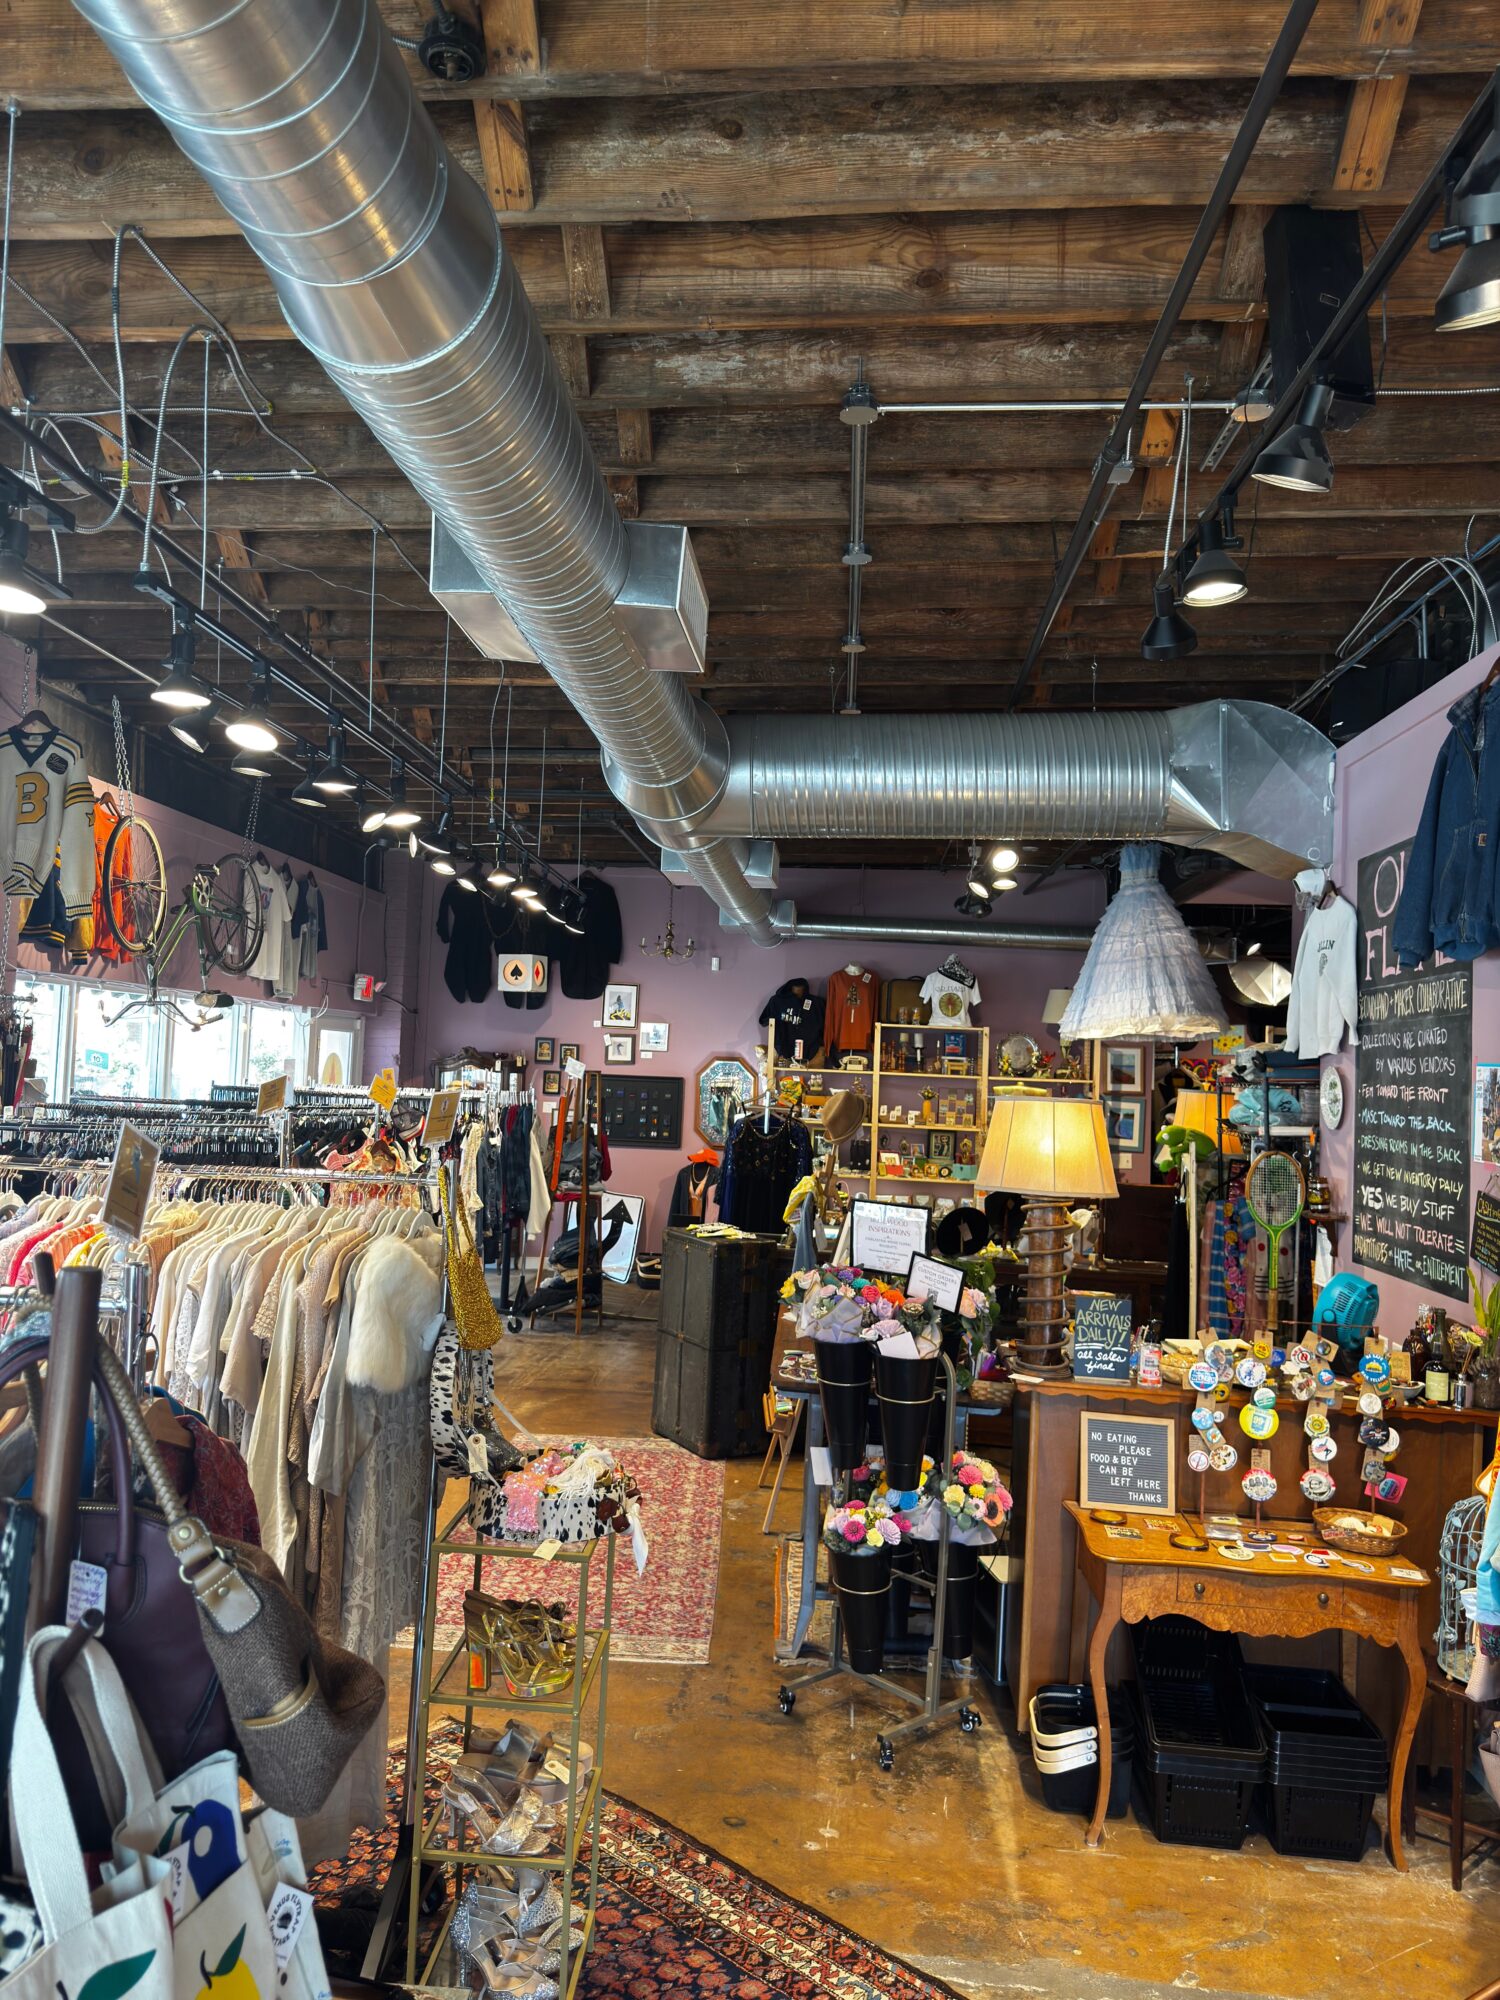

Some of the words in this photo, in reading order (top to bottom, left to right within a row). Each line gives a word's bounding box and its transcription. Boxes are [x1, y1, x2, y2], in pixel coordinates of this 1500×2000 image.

[16, 771, 50, 825] B
[1394, 985, 1414, 1018] MAKER
[1416, 977, 1467, 1013] COLLABORATIVE
[1362, 1032, 1401, 1050] COLLECTIONS
[1403, 1032, 1415, 1050] ARE
[1418, 1027, 1448, 1047] CURATED
[1375, 1058, 1384, 1073] BY
[1387, 1056, 1416, 1078] VARIOUS
[1419, 1056, 1456, 1076] VENDORS
[1361, 1083, 1374, 1098] FEM
[1376, 1084, 1398, 1099] TOWARD
[1399, 1085, 1415, 1102] THE
[1418, 1086, 1449, 1104] FRONT
[1361, 1108, 1378, 1125] MASC
[1378, 1110, 1406, 1128] TOWARD
[1408, 1116, 1425, 1130] THE
[1426, 1116, 1455, 1133] BACK
[1361, 1135, 1388, 1153] DRESSING
[1388, 1138, 1408, 1155] ROOMS
[1410, 1142, 1418, 1157] IN
[1419, 1143, 1435, 1160] THE
[1436, 1145, 1463, 1164] BACK
[1361, 1160, 1372, 1175] WE
[1373, 1161, 1385, 1179] GET
[1386, 1165, 1403, 1181] NEW
[1403, 1169, 1438, 1193] INVENTORY
[1439, 1178, 1464, 1201] DAILY
[1385, 1192, 1398, 1208] WE
[1400, 1195, 1421, 1218] BUY
[1421, 1200, 1455, 1221] STUFF
[1360, 1212, 1373, 1231] WE
[1375, 1215, 1394, 1236] WILL
[1395, 1220, 1412, 1240] NOT
[1413, 1225, 1455, 1254] TOLERATE
[1393, 1247, 1415, 1273] HATE
[1422, 1255, 1466, 1290] ENTITLEMENT
[1089, 1299, 1122, 1312] NEW
[1076, 1309, 1131, 1332] ARRIVALS
[1076, 1325, 1127, 1349] DAILY!
[1077, 1351, 1093, 1359] all
[1095, 1351, 1126, 1362] sales
[1085, 1361, 1115, 1373] final
[1091, 1432, 1102, 1441] NO
[1107, 1433, 1137, 1444] EATING
[1090, 1453, 1110, 1463] FOOD
[1112, 1455, 1119, 1464] &
[1120, 1456, 1138, 1466] BEV
[1119, 1445, 1152, 1456] PLEASE
[1099, 1465, 1117, 1475] CAN
[1122, 1467, 1134, 1477] BE
[1110, 1477, 1130, 1487] LEFT
[1137, 1479, 1161, 1490] HERE
[1128, 1492, 1162, 1503] THANKS
[269, 1893, 290, 1922] VENUS
